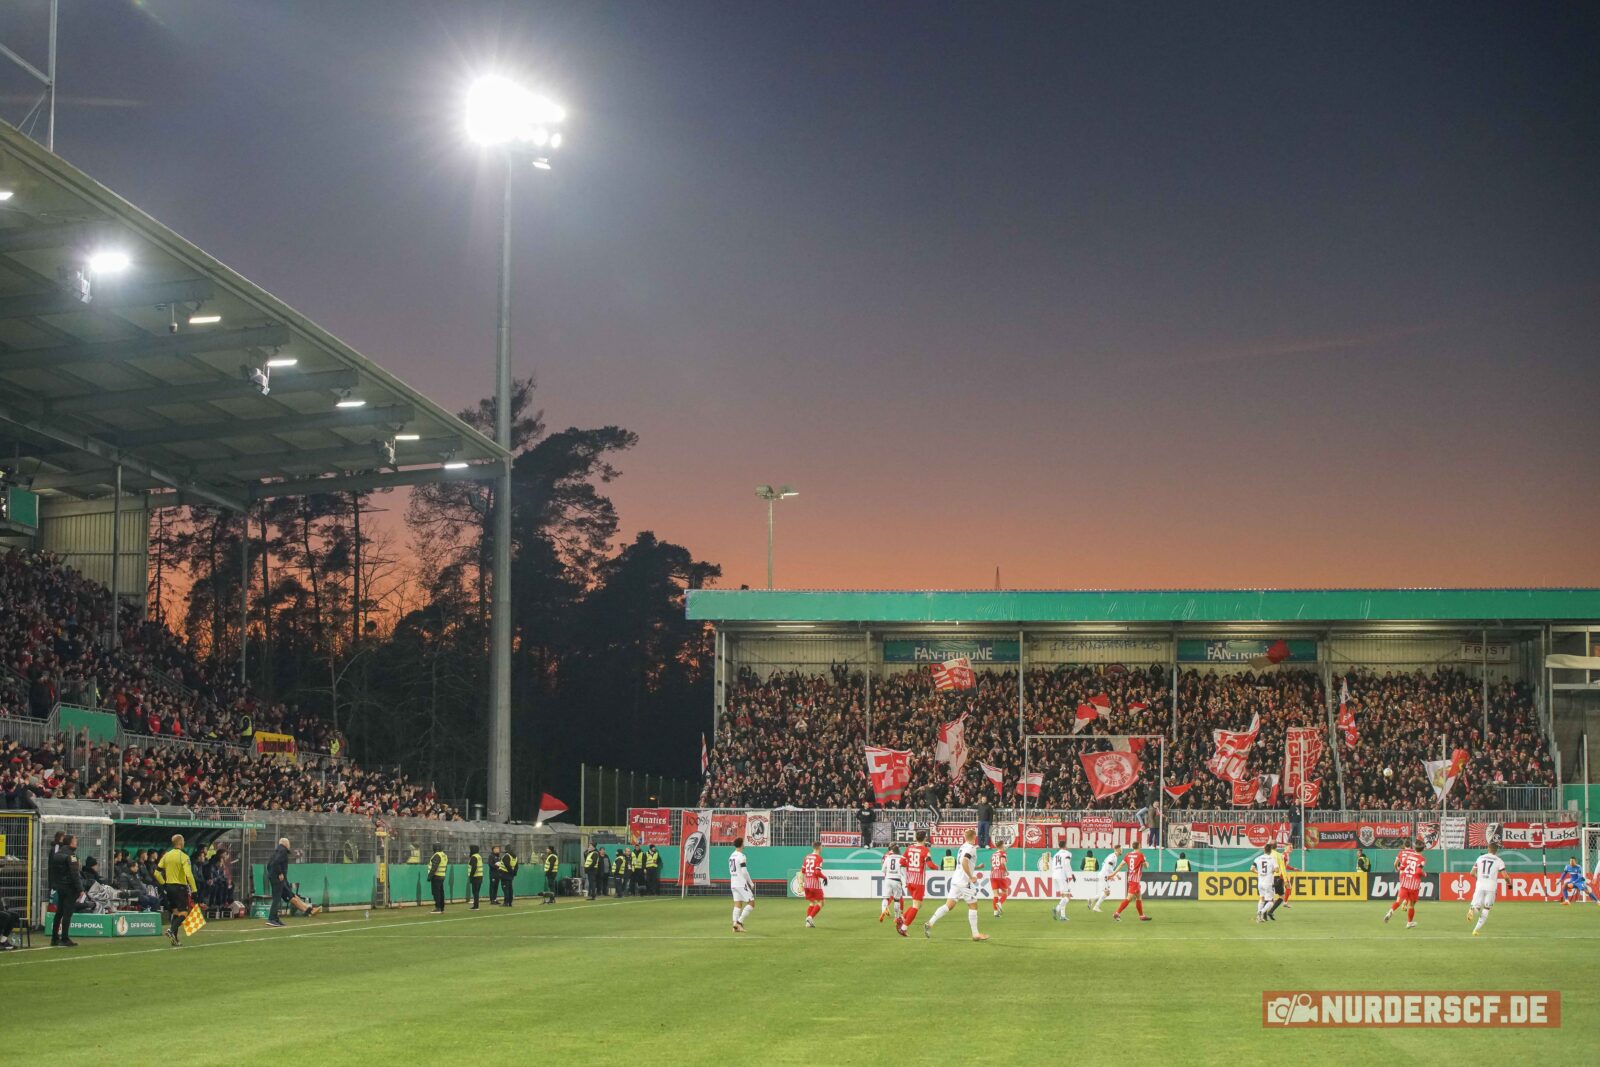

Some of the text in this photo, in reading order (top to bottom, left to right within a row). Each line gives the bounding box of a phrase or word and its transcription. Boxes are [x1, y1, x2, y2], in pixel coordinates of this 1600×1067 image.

[631, 814, 667, 824] Fanatics
[685, 815, 709, 826] 100%
[1505, 828, 1578, 840] Red Label
[933, 837, 964, 845] ULTRAS
[890, 858, 896, 870] 8
[907, 851, 920, 867] 38
[1055, 855, 1062, 865] 14
[1129, 858, 1135, 870] 8
[805, 858, 815, 873] 22
[1261, 861, 1268, 873] 5
[1404, 860, 1416, 874] 29
[1481, 860, 1494, 875] 17
[1205, 876, 1360, 896] SPORETTEN
